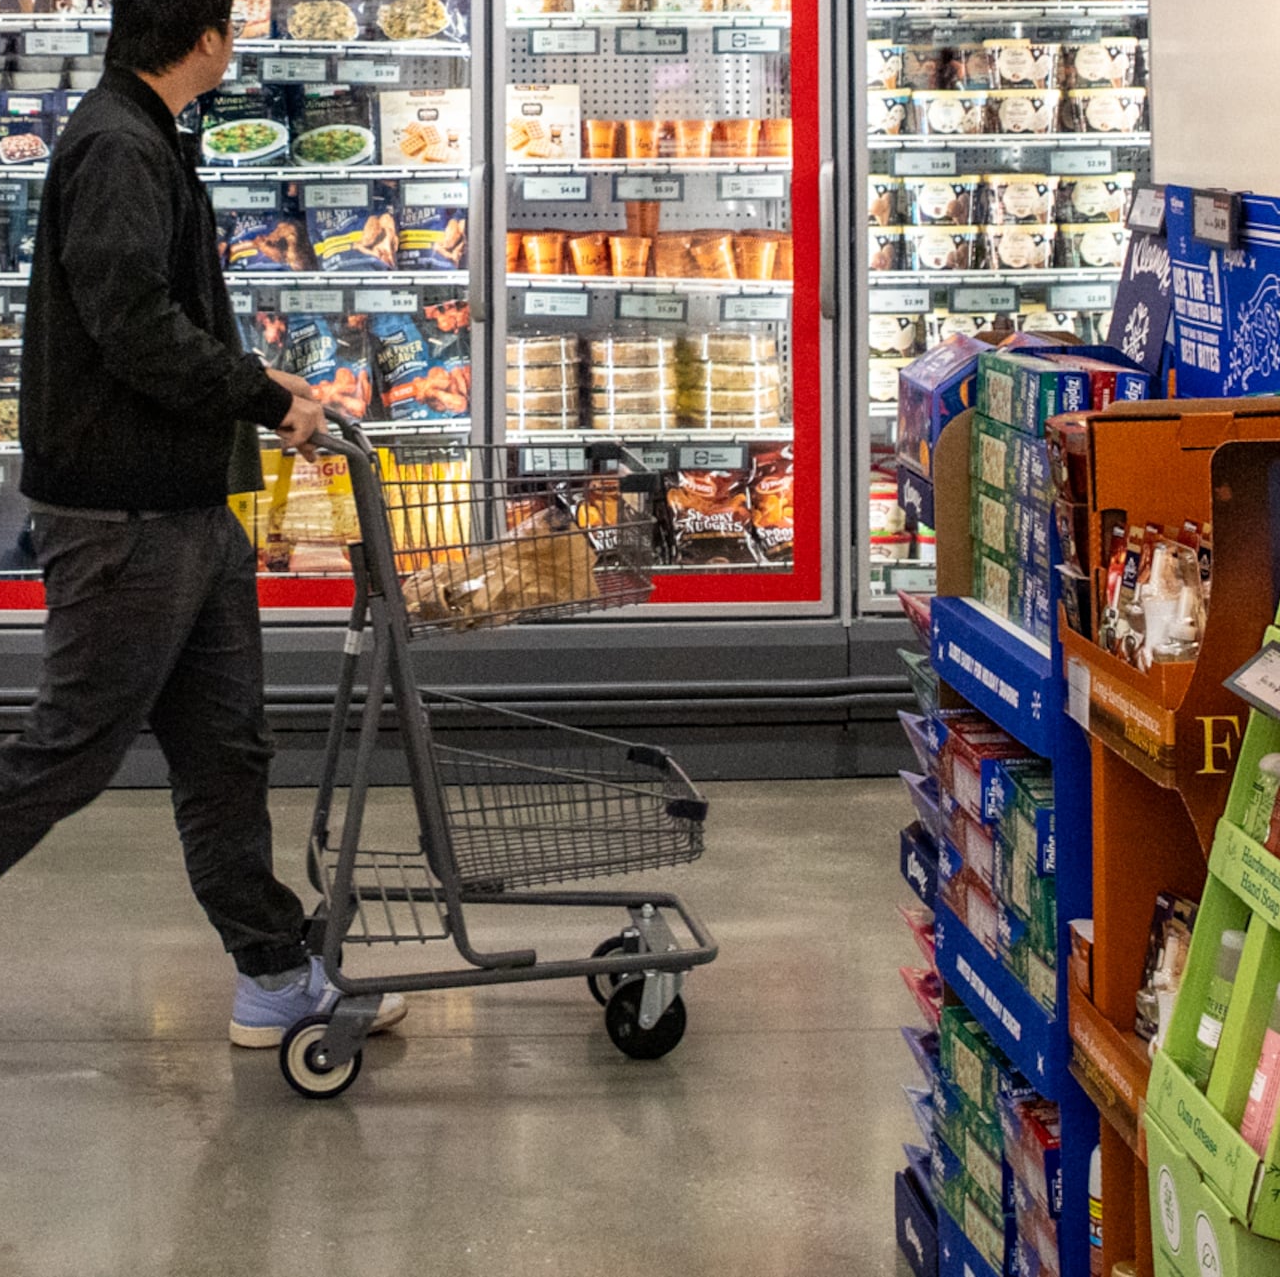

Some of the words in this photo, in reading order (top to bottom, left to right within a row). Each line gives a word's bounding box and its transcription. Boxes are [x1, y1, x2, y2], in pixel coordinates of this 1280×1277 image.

[1125, 380, 1142, 400] Zip
[687, 508, 734, 524] SPOOKY
[685, 517, 744, 534] NUGGETS
[757, 527, 793, 540] SPOO
[1240, 870, 1262, 900] Hand
[1261, 887, 1280, 921] Soap
[1193, 1117, 1218, 1157] Grease
